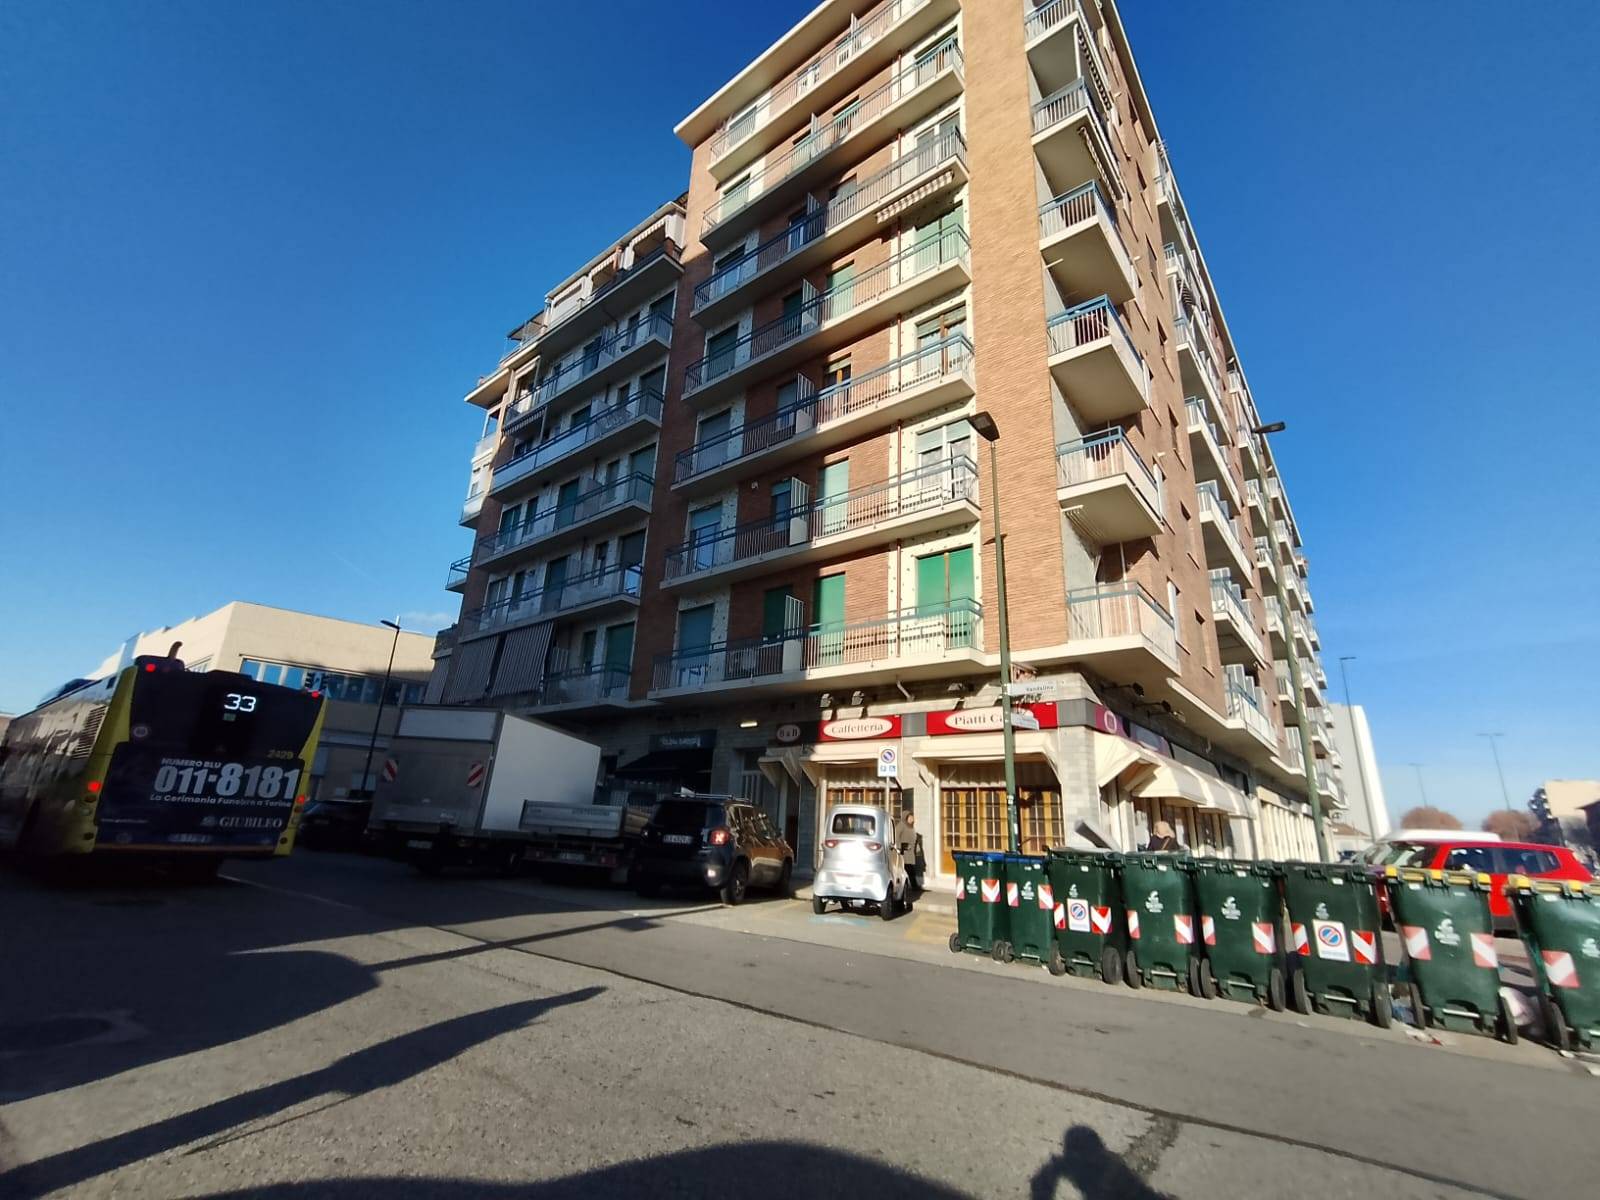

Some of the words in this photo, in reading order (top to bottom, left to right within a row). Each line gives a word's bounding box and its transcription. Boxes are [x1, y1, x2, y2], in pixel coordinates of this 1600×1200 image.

[224, 693, 257, 712] 33
[955, 713, 986, 725] Piatti
[831, 723, 884, 734] Caffetteria
[161, 758, 202, 767] NUMERO
[203, 760, 222, 769] BLU
[154, 763, 300, 799] 011-8181
